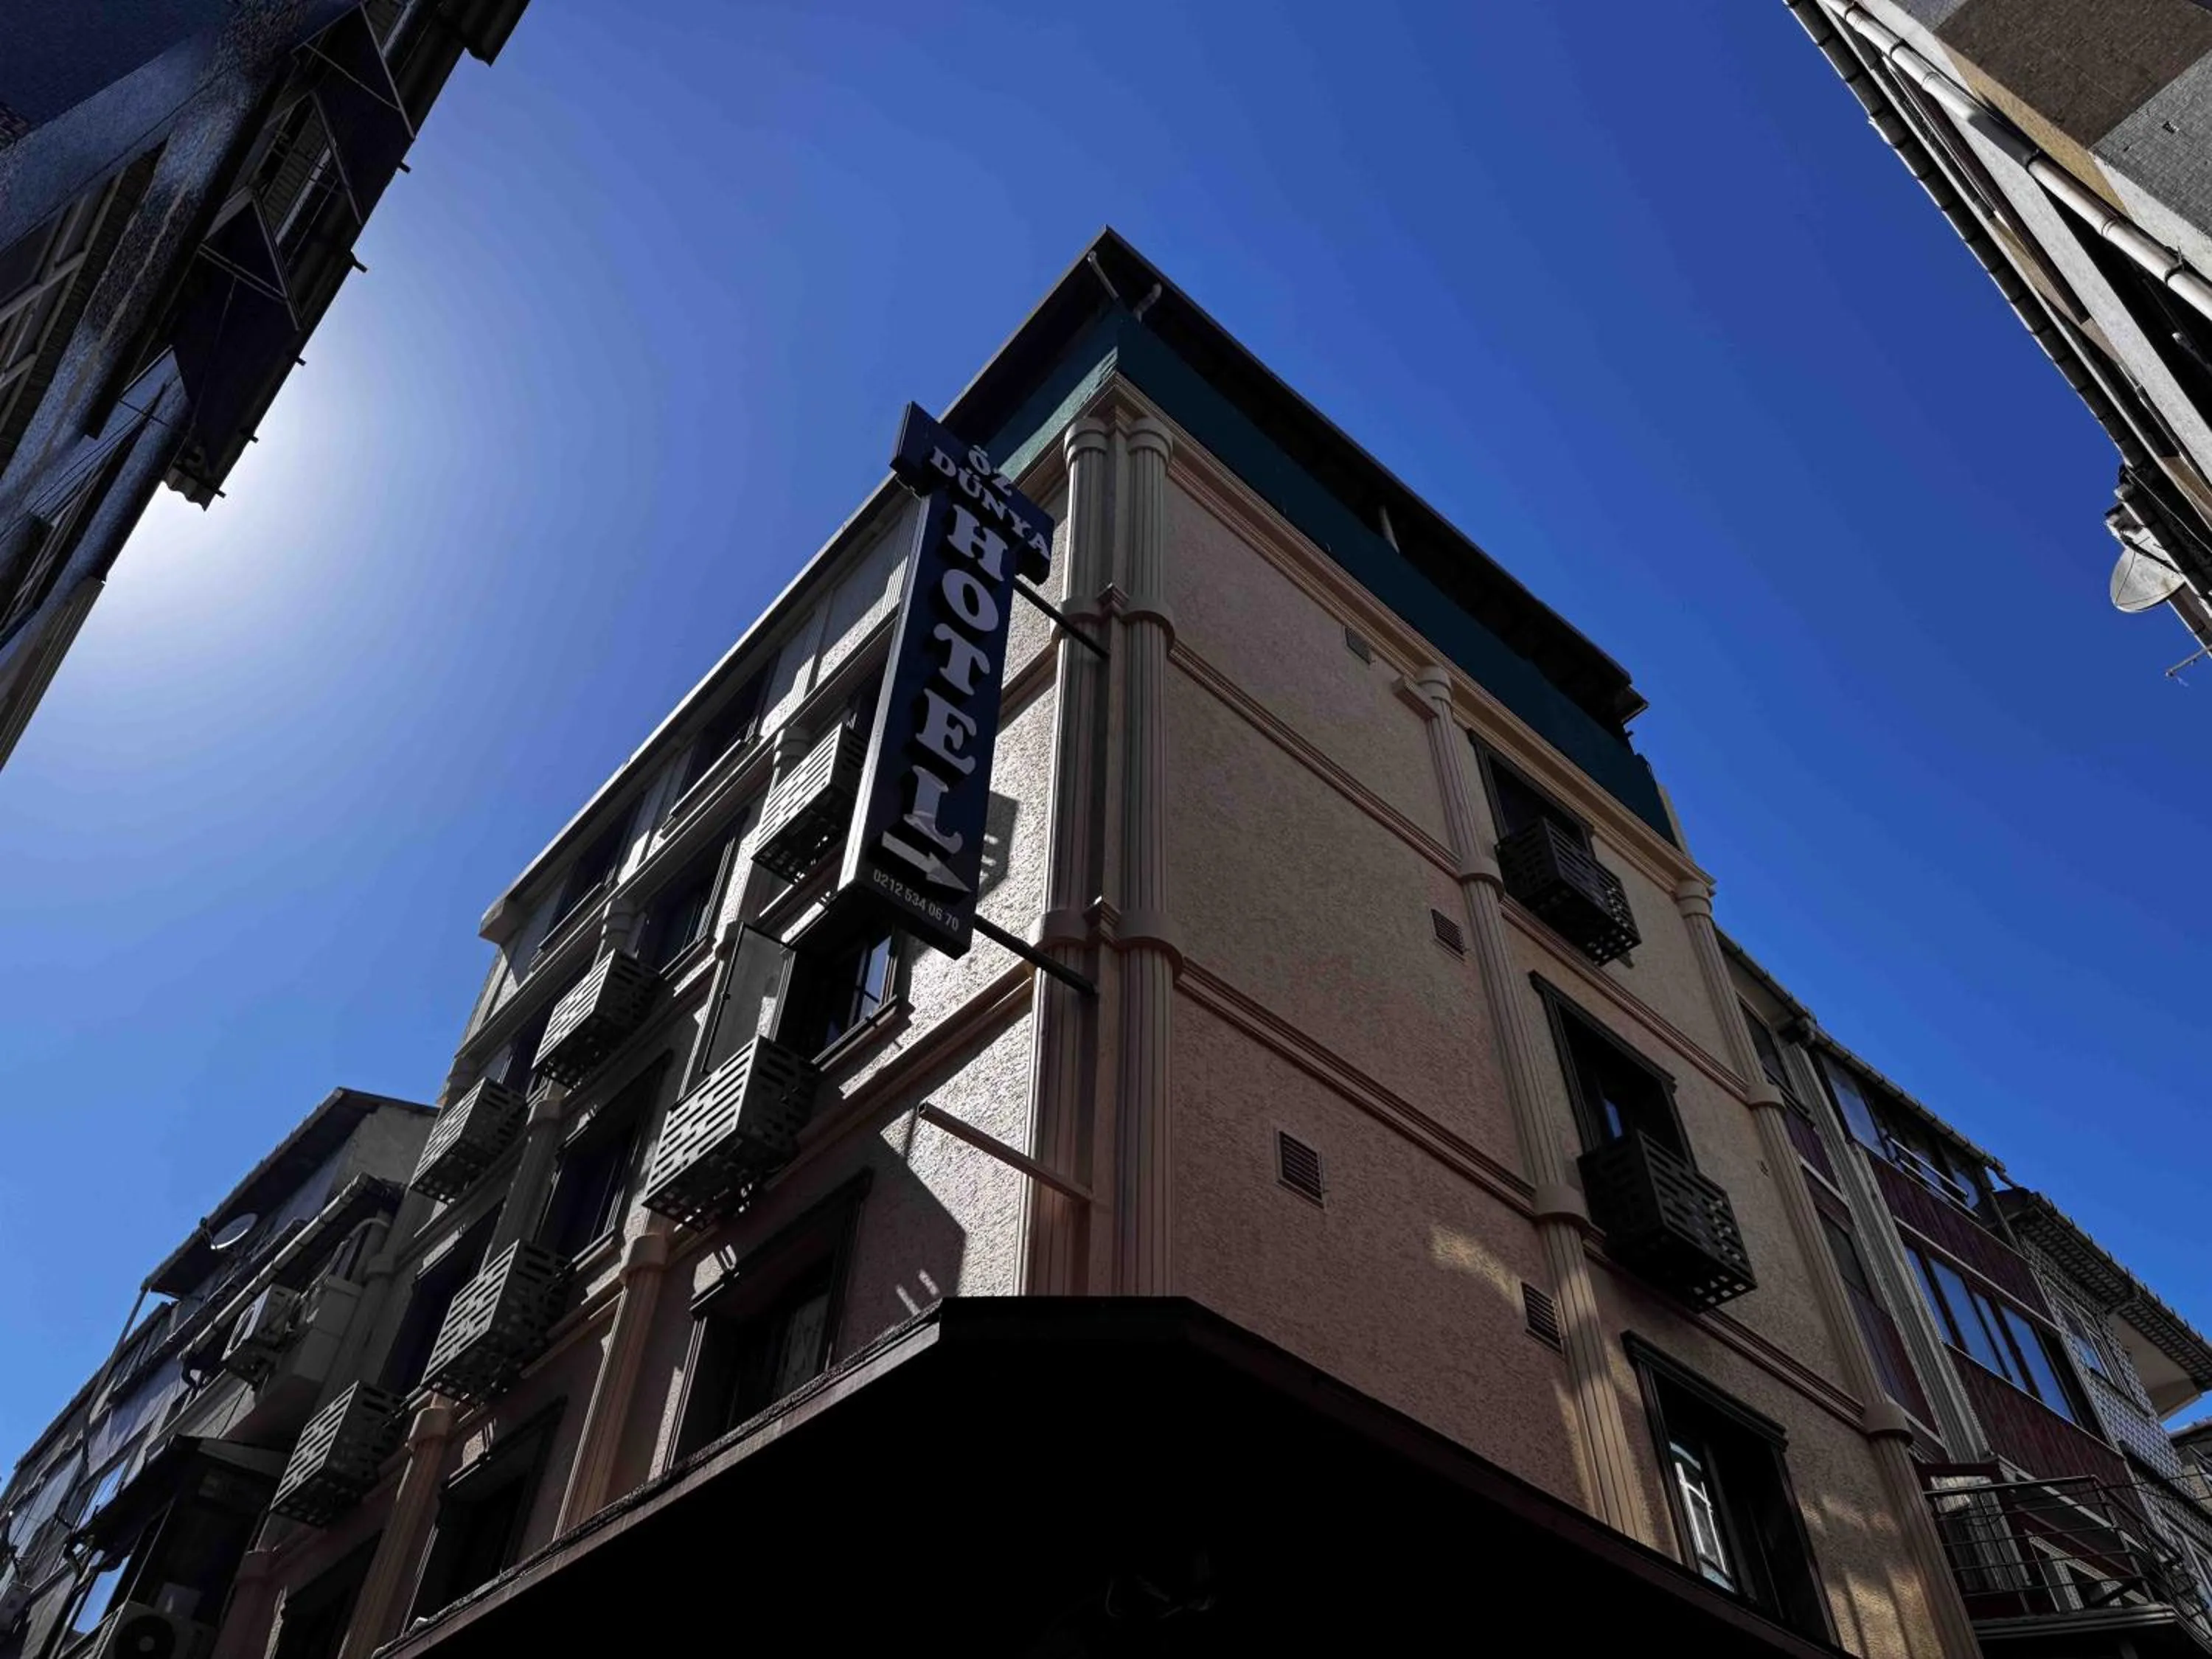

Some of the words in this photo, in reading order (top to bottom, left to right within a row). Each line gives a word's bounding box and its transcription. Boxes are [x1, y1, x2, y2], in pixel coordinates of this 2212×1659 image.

[929, 446, 1051, 560] DÜNYA
[967, 445, 1013, 497] ÖZ
[904, 504, 1009, 854] HOTEL
[873, 869, 902, 897] 0212
[904, 887, 928, 911] 534
[945, 912, 959, 931] 70
